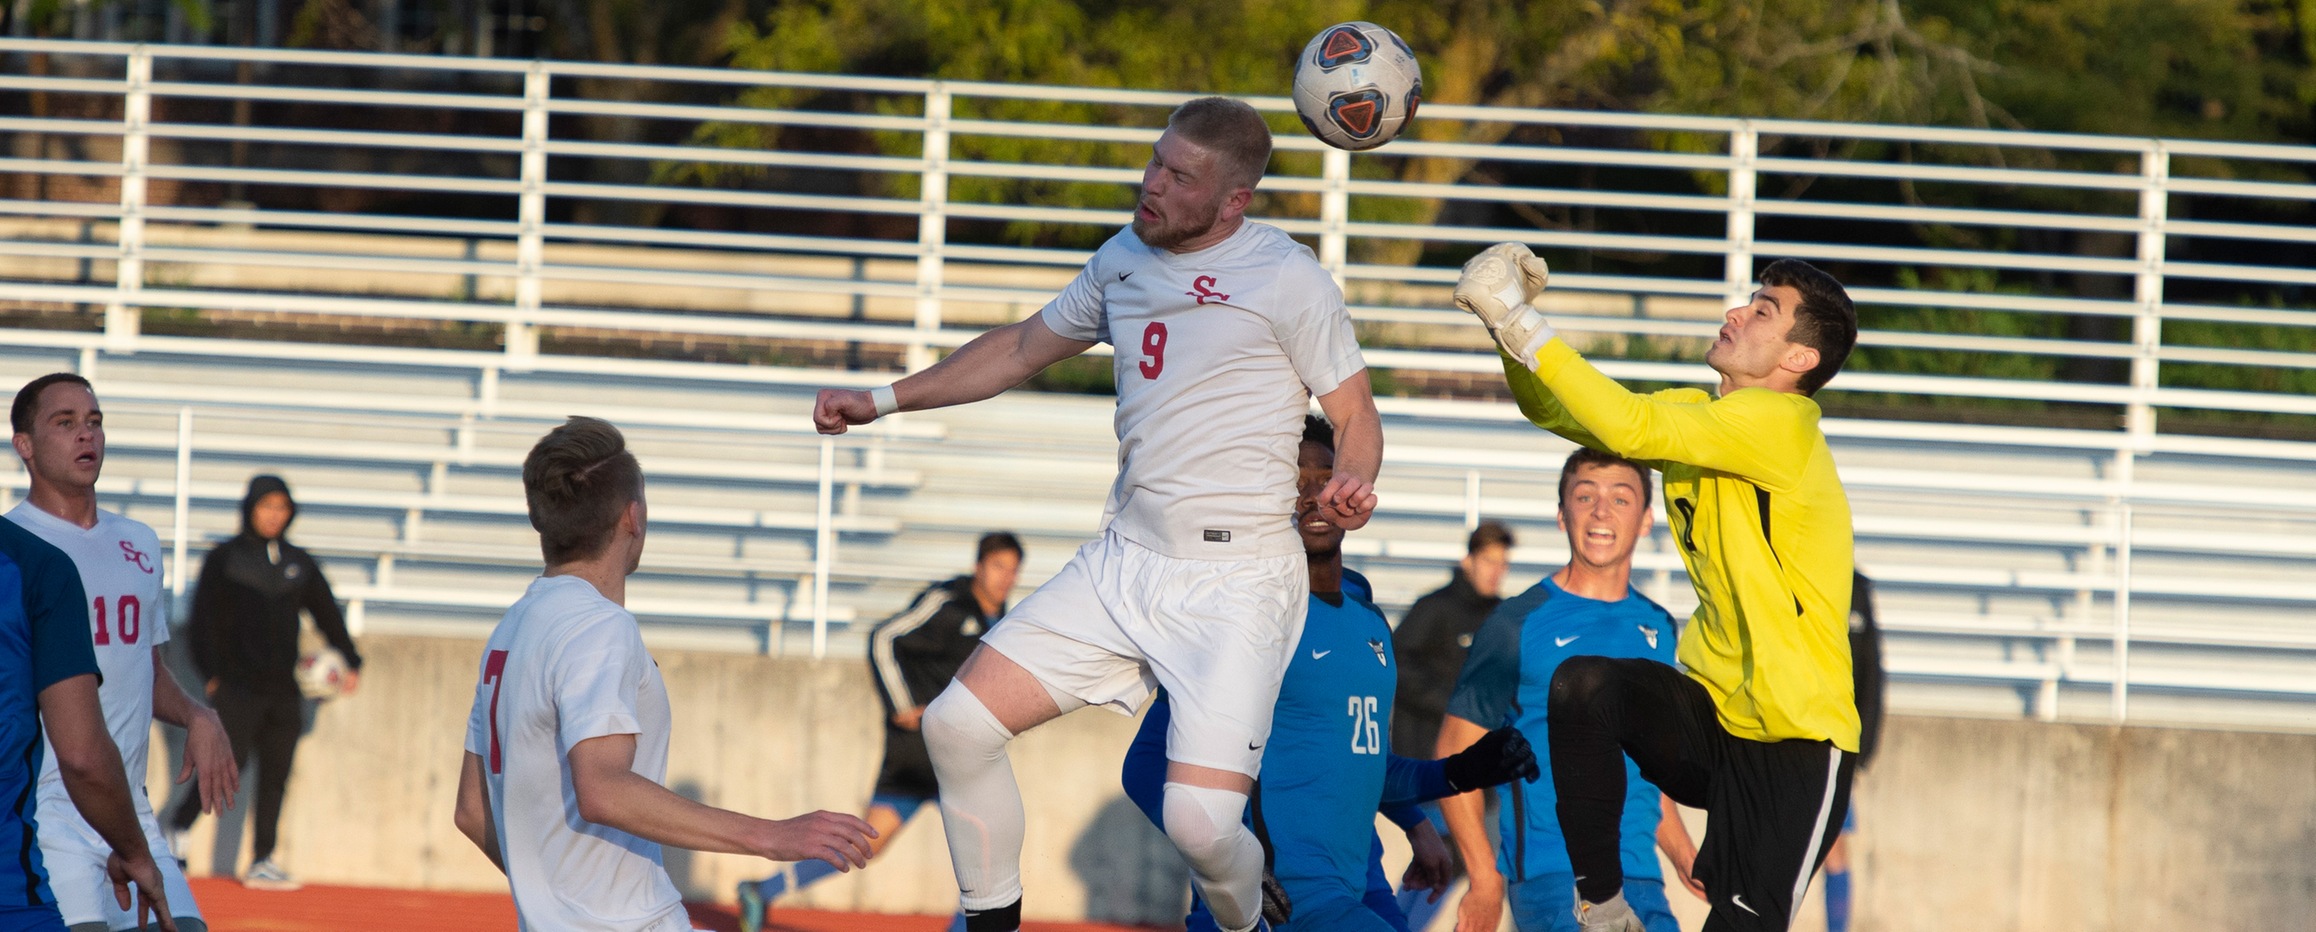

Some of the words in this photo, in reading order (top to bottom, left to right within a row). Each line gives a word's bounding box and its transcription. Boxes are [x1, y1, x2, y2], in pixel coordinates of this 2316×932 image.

[1139, 321, 1168, 380] 9
[119, 541, 153, 574] SC
[94, 595, 140, 645] 10
[483, 650, 509, 774] 7
[1348, 696, 1380, 754] 26
